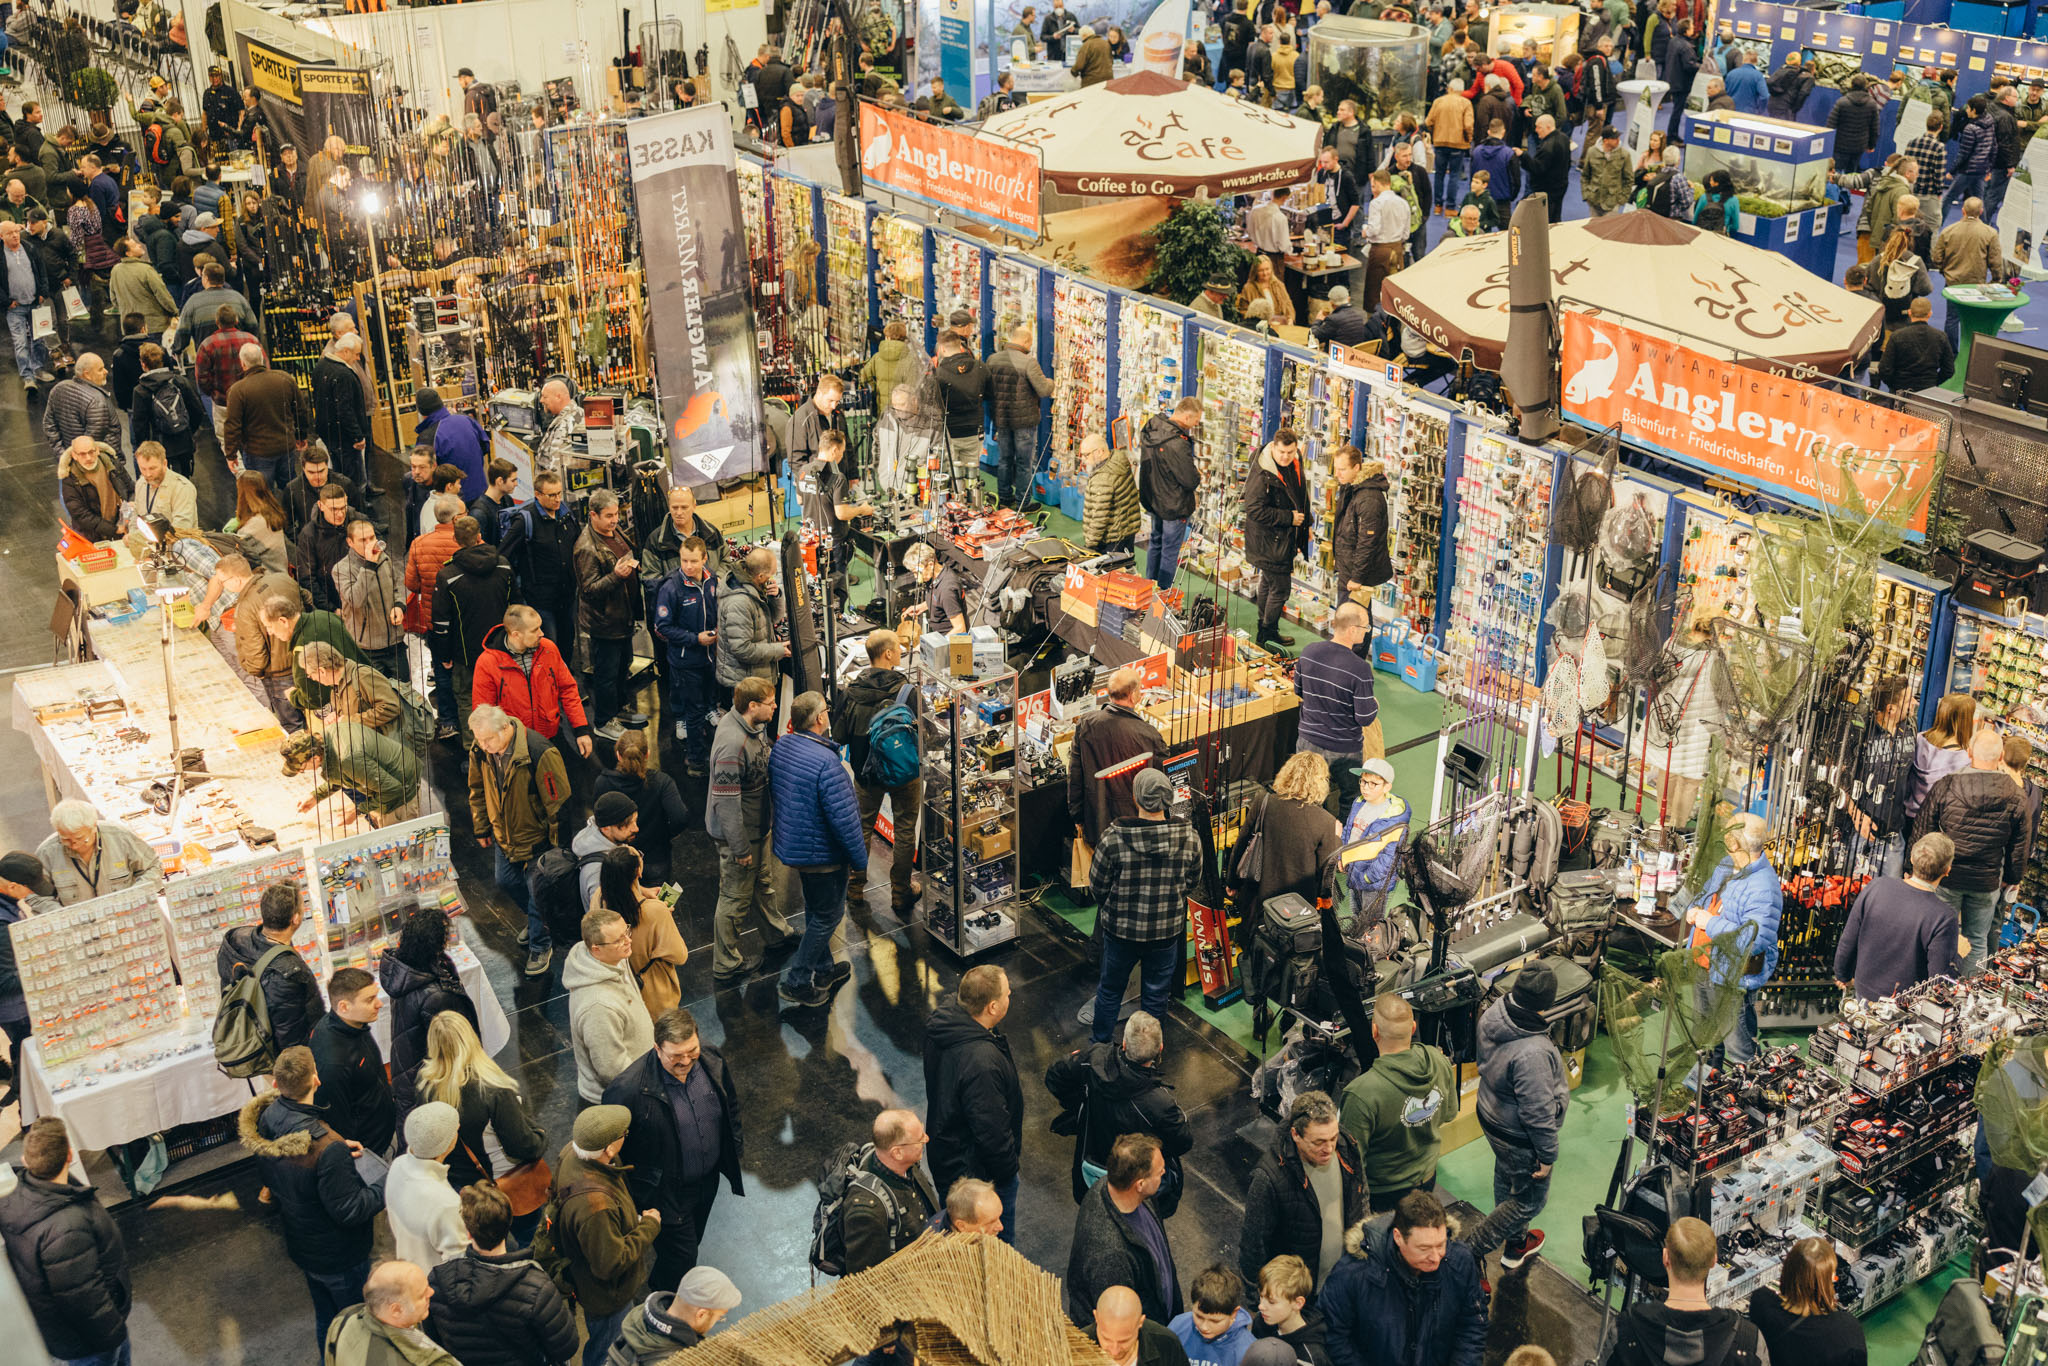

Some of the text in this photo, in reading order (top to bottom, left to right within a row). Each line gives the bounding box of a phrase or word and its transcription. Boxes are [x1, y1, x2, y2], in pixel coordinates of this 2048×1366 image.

[250, 50, 290, 82] SPORTEX
[303, 74, 350, 84] SPORTEX
[896, 134, 1034, 204] Anglermarkt
[1222, 167, 1300, 189] www.art-cafe.eu
[1077, 177, 1175, 195] Coffee to Go
[1007, 206, 1035, 225] Bregenz
[1393, 297, 1449, 347] Coffee to Go
[1769, 362, 1819, 380] to Go
[1625, 361, 1921, 491] Anglermarkt
[1622, 407, 1677, 440] Baienfurt
[1688, 431, 1785, 476] Friedrichshafen
[1167, 758, 1197, 774] SHIMANO
